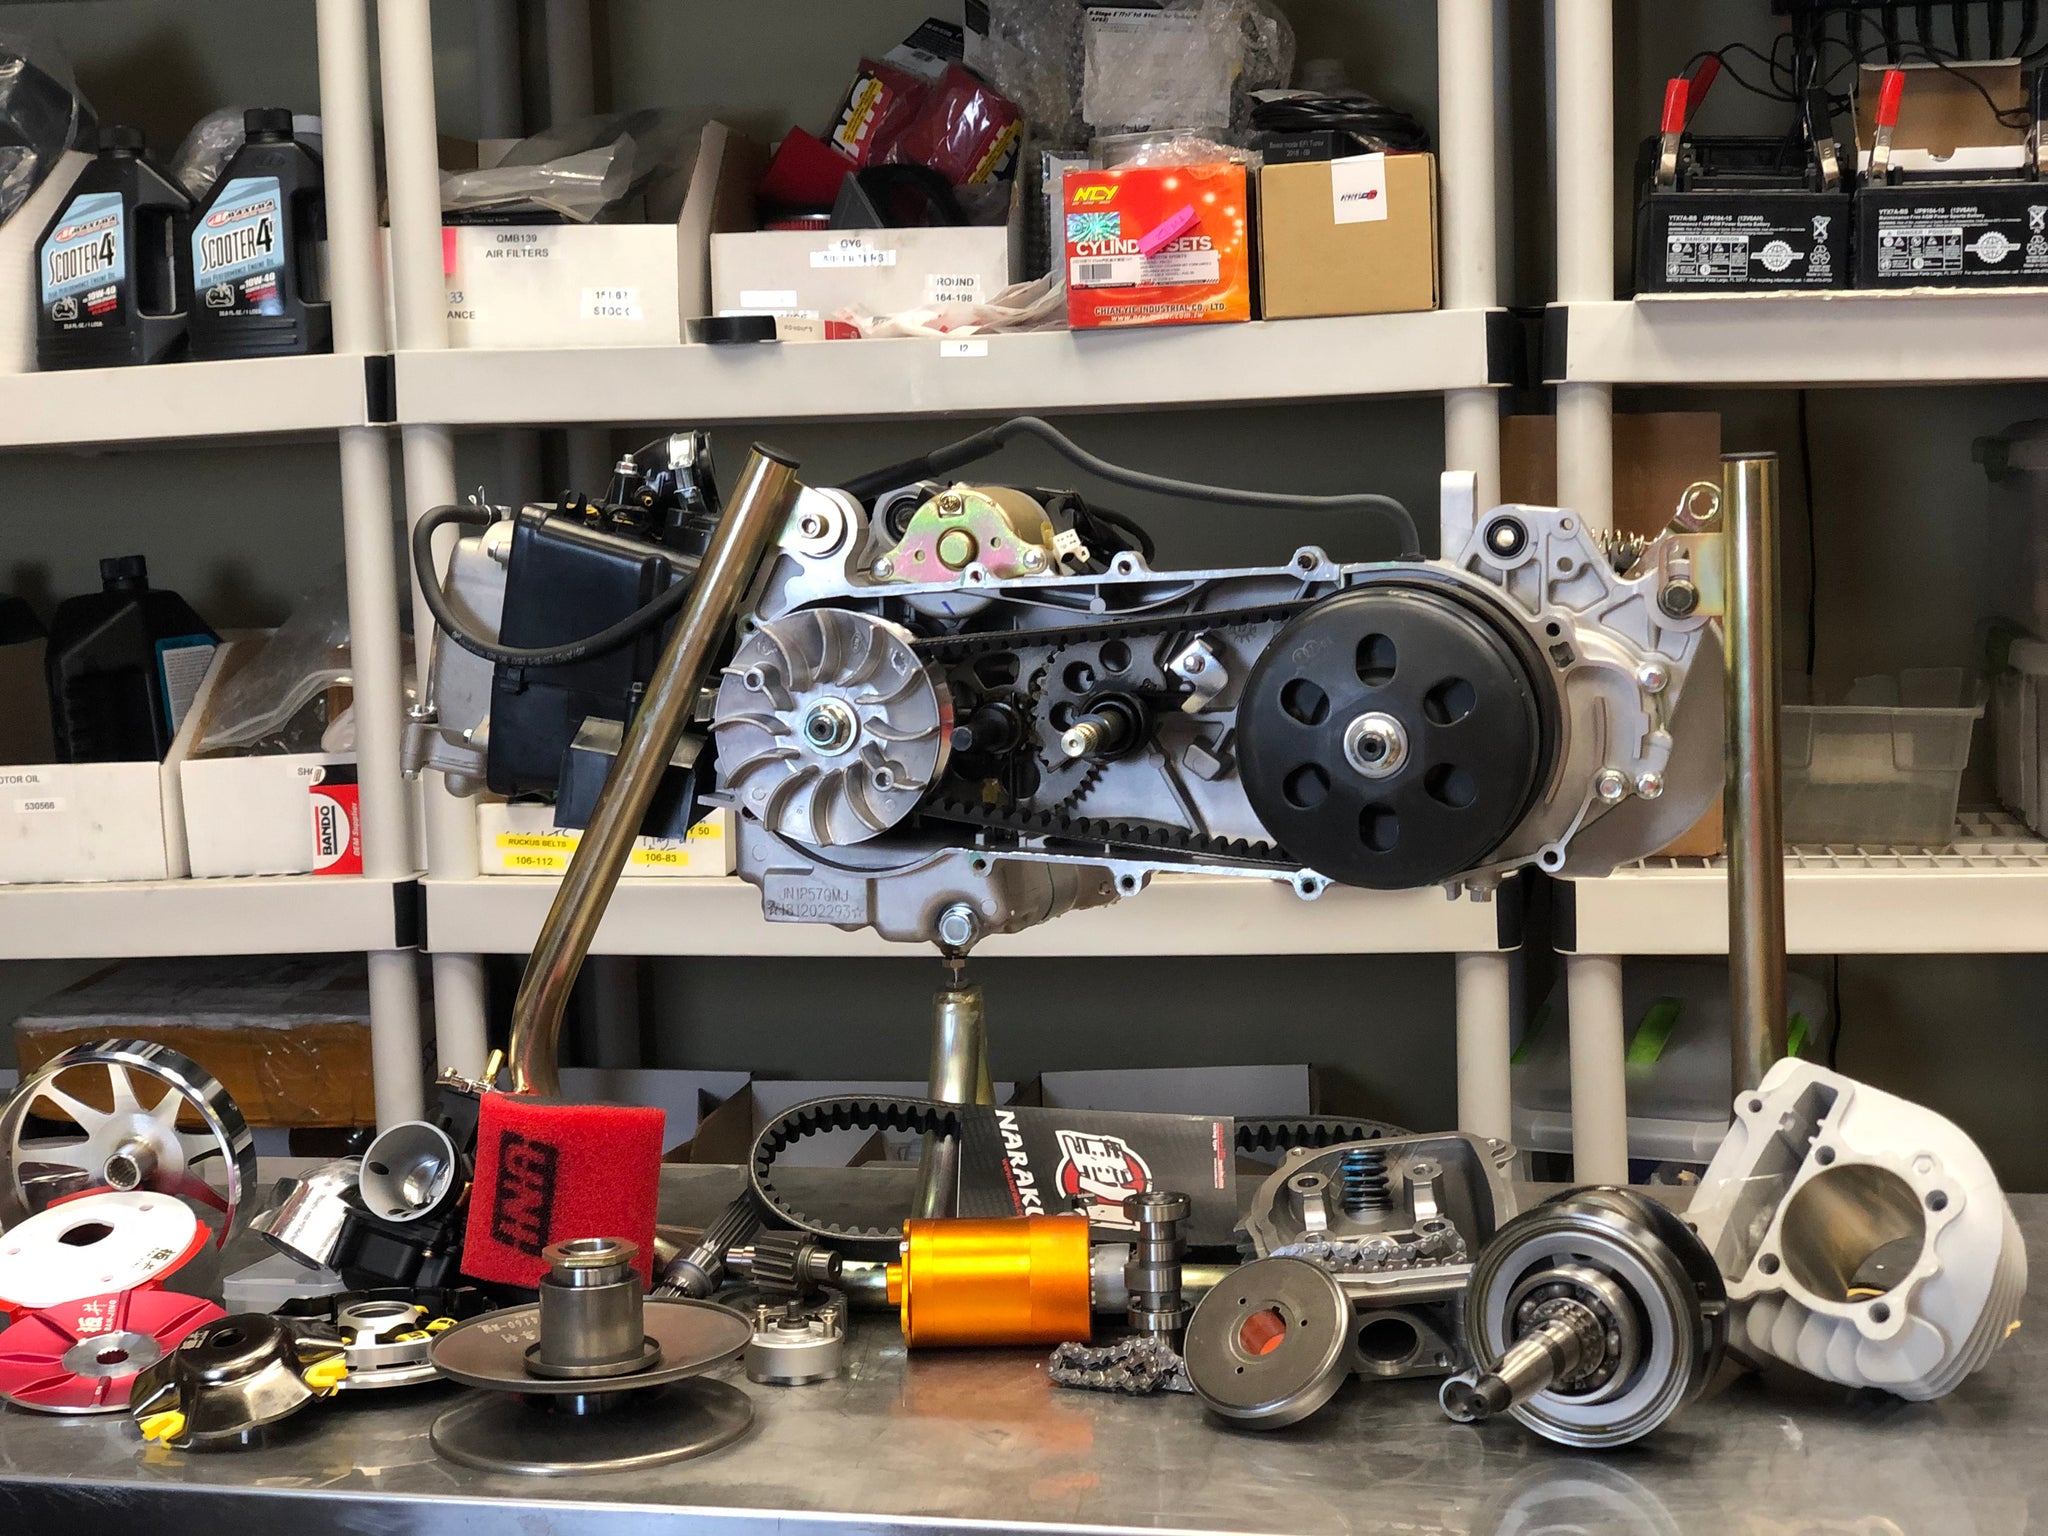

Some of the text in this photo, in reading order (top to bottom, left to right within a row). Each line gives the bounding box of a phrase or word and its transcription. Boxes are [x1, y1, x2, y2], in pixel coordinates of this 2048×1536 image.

[1073, 186, 1119, 201] NCY
[496, 234, 537, 243] QMB139
[200, 227, 257, 272] SCOOTER
[1076, 239, 1163, 255] CYLIND
[486, 248, 549, 258] AIR FILTERS
[48, 241, 99, 286] SCOOTER
[1139, 303, 1189, 314] INDUSTRIAL
[25, 774, 40, 783] OIL
[351, 801, 360, 836] Supplier
[320, 805, 333, 856] BANDO
[698, 826, 710, 835] 50
[508, 838, 567, 848] RUCKUS BELTS
[516, 856, 553, 866] 106-112
[645, 853, 677, 862] 106-83
